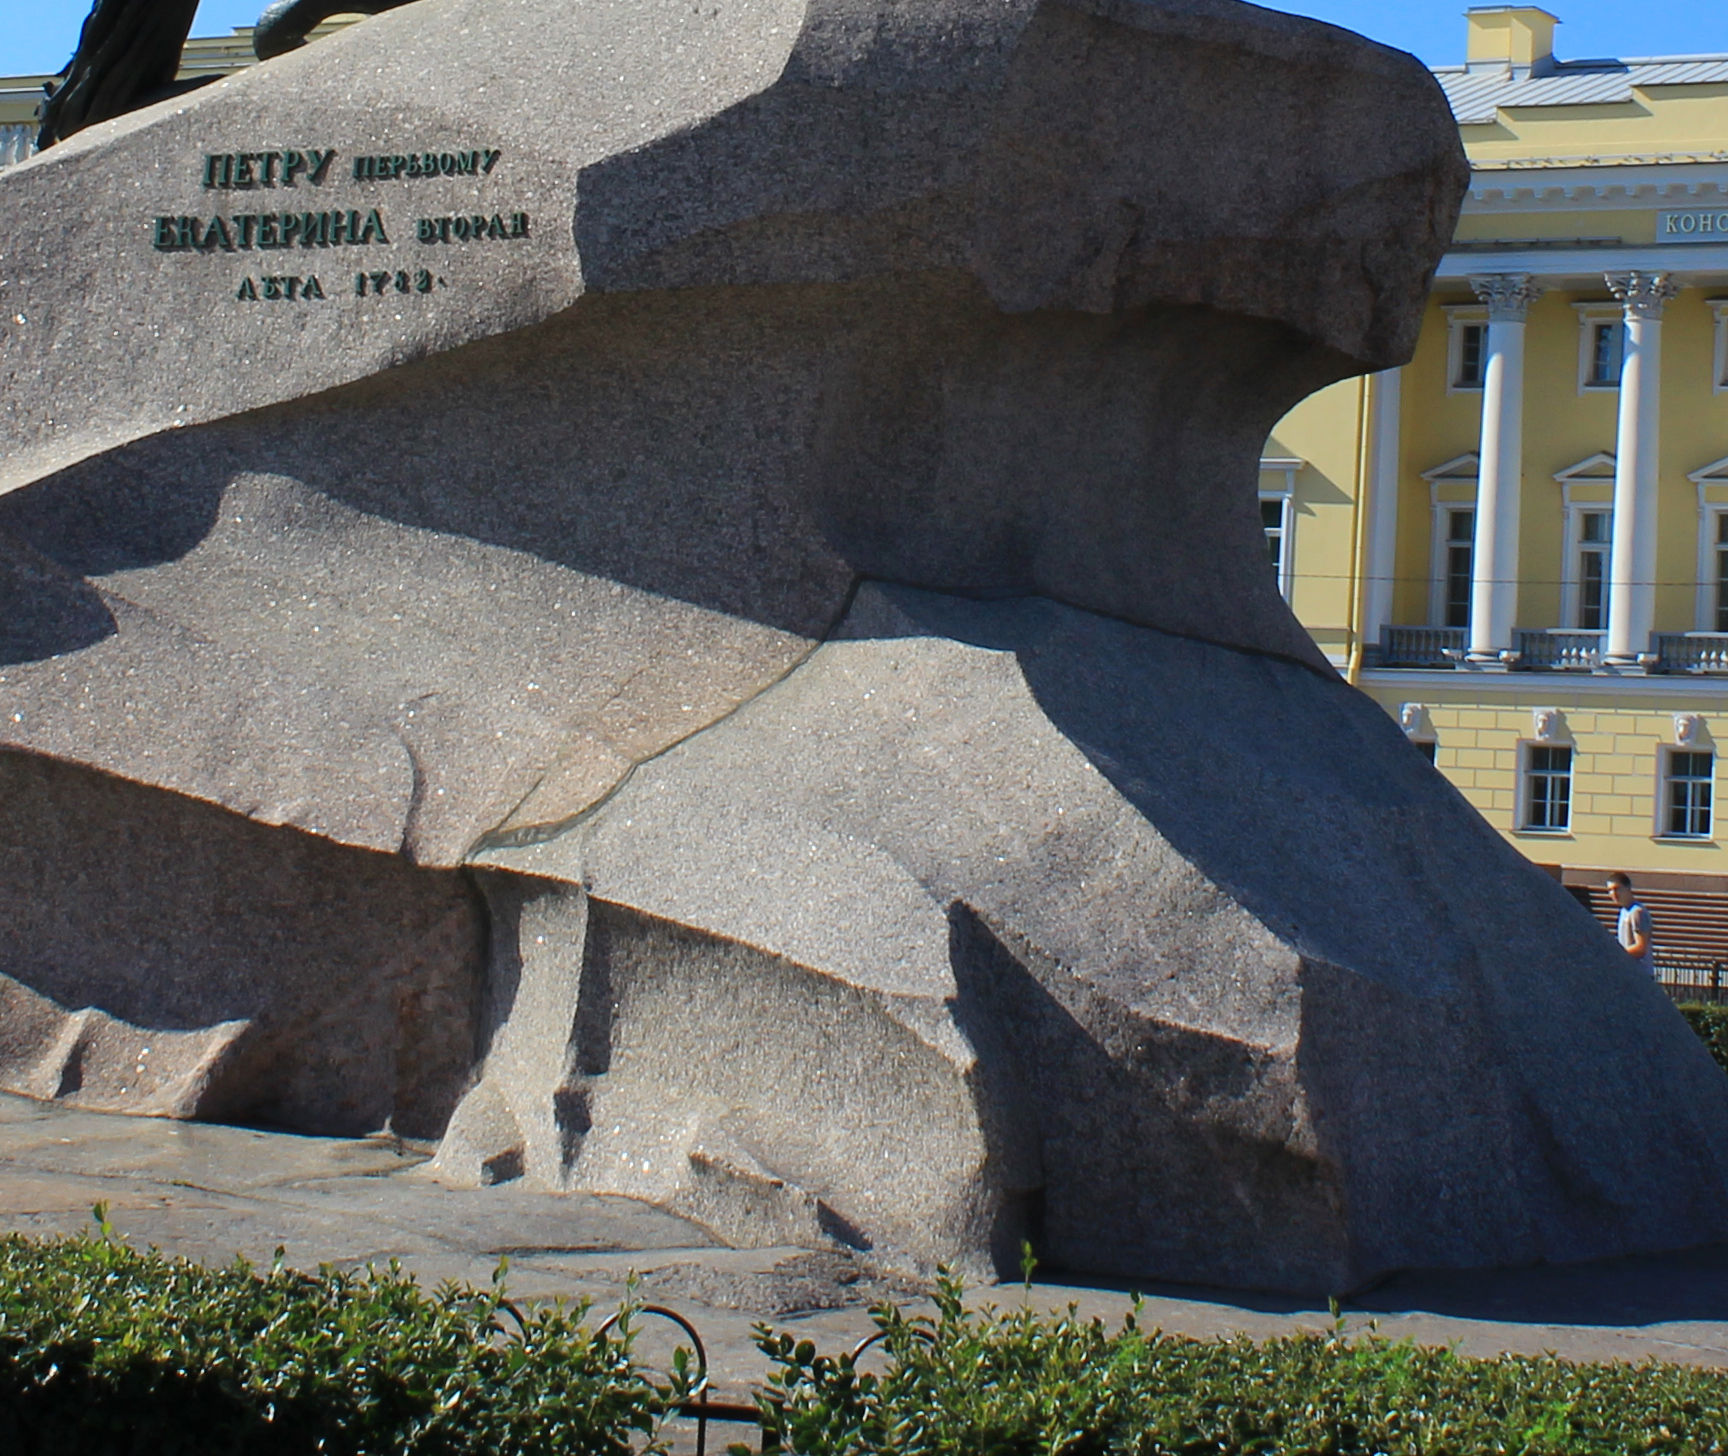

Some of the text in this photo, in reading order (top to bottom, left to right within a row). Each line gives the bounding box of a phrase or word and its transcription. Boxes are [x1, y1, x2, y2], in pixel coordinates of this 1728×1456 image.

[202, 149, 336, 186] ПЕТРУ
[153, 209, 529, 250] ЕКАТЕРИНА ВТОРАЯ
